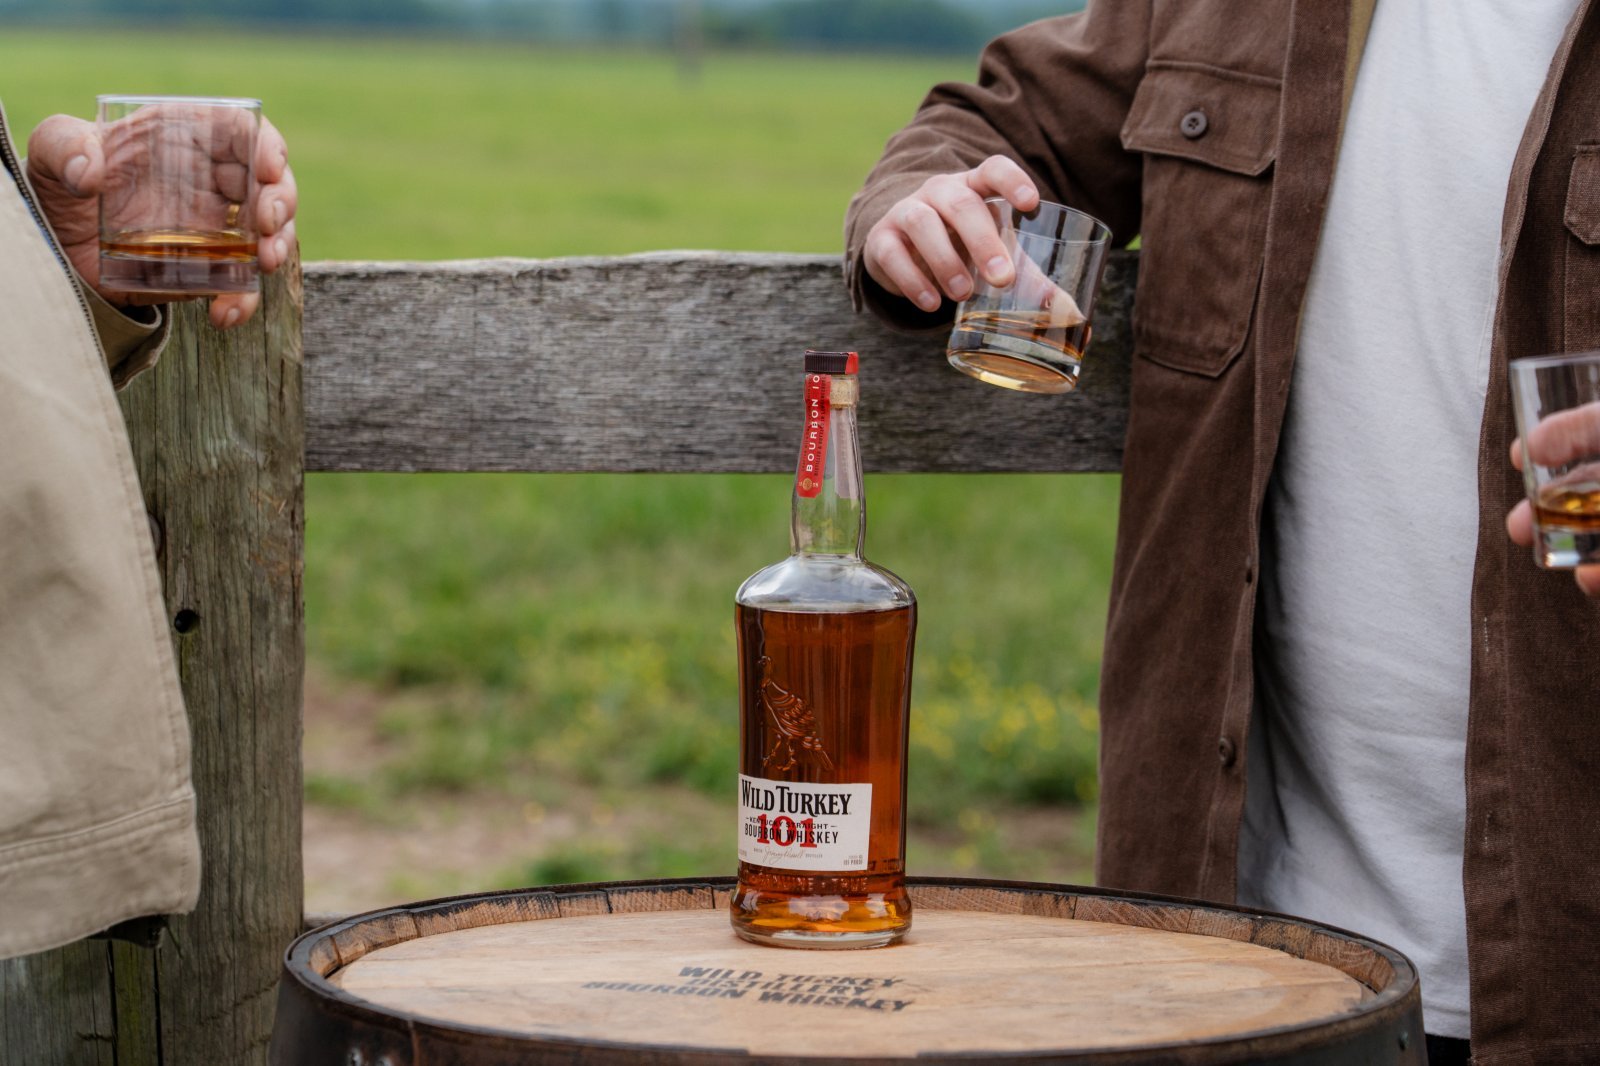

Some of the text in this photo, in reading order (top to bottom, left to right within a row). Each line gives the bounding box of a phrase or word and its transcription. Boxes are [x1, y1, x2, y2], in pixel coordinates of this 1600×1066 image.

[806, 399, 819, 472] BOURBON
[742, 779, 852, 817] WILD TURKEY
[745, 823, 839, 844] BOURBON WHISKEY
[757, 813, 817, 848] 101
[786, 822, 828, 830] STRAIGHT
[678, 966, 905, 988] WILD TURKEY
[686, 978, 872, 997] DISTILLERY
[581, 981, 914, 1012] BOURBON WHISKEY
